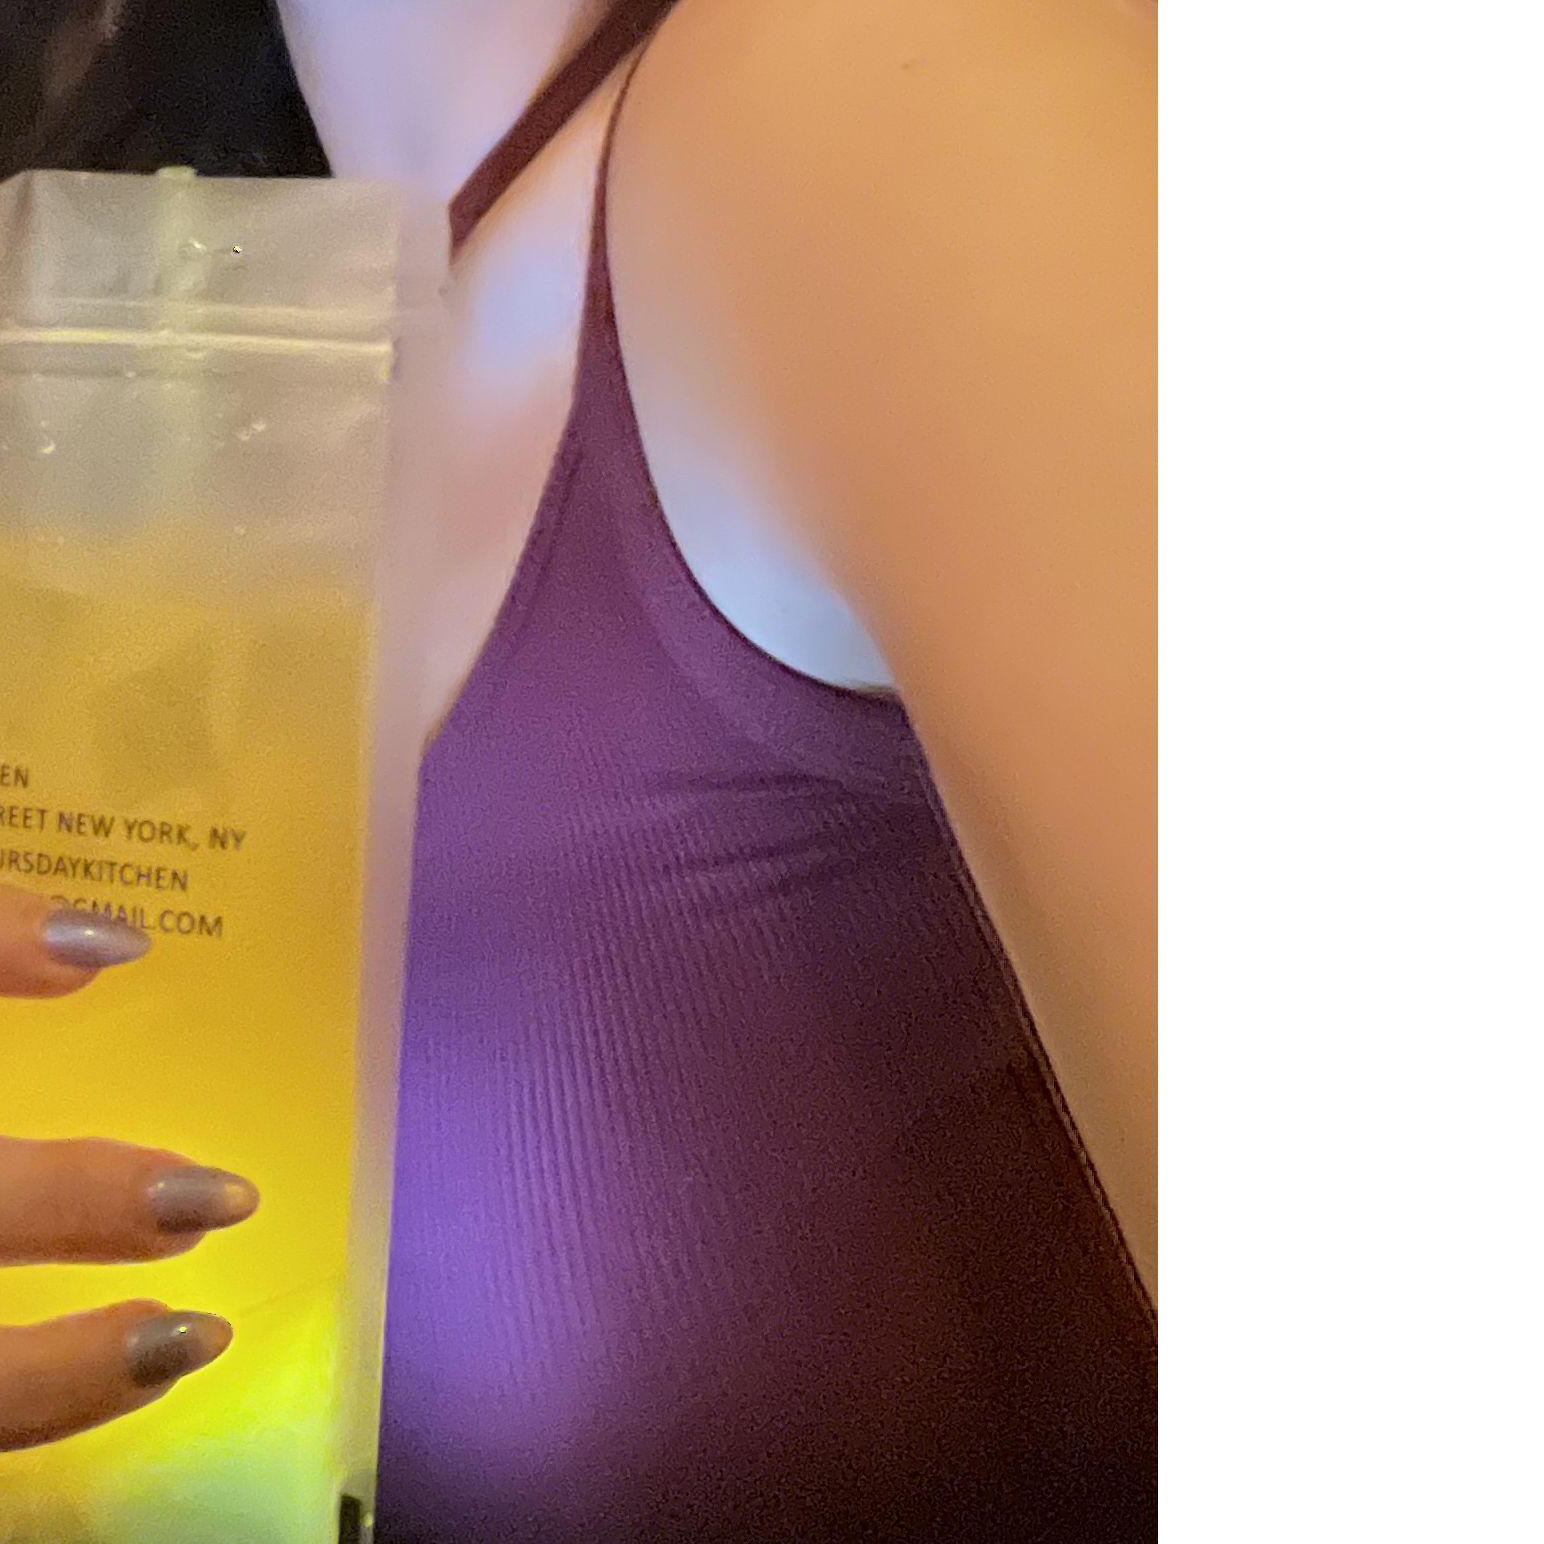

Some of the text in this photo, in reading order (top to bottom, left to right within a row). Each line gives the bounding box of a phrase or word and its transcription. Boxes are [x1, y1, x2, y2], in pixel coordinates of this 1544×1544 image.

[58, 811, 115, 838] NEW
[123, 817, 199, 851] YORK,
[209, 825, 246, 851] NY
